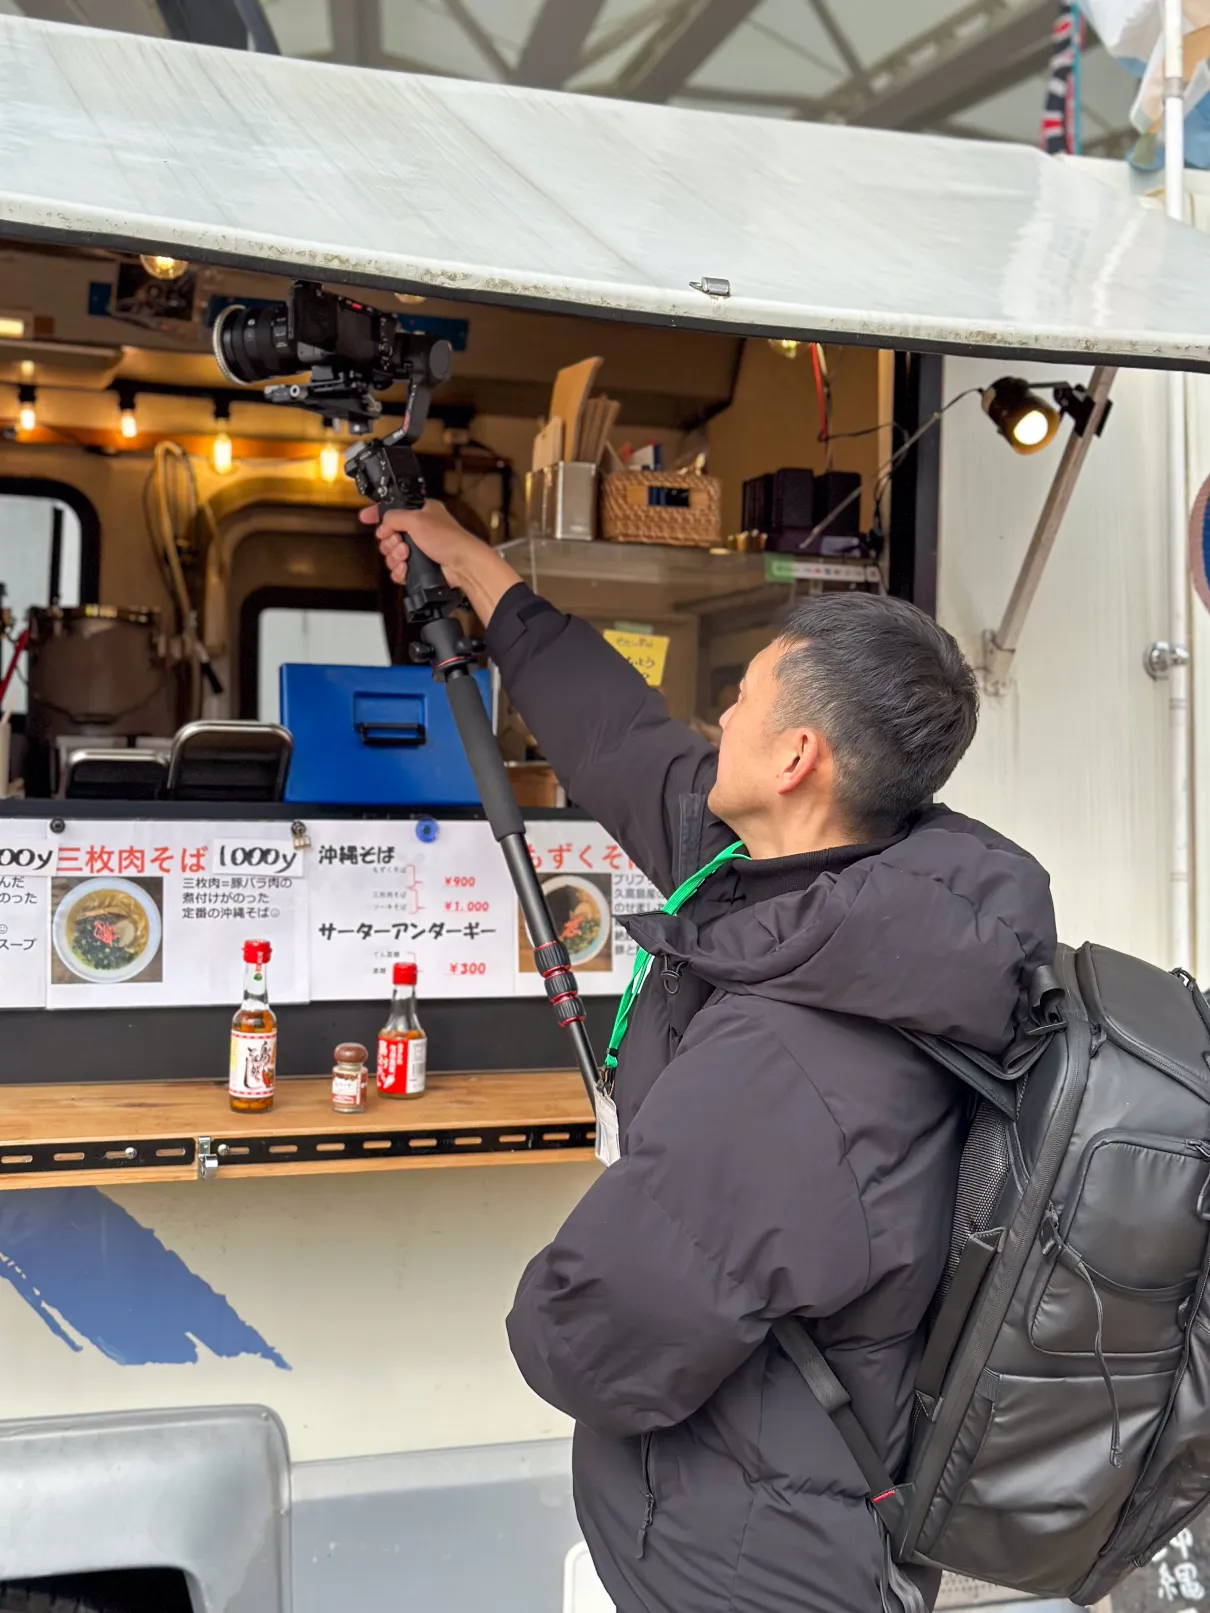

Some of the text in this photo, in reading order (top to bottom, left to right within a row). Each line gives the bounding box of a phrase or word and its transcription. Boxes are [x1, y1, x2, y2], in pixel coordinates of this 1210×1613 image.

[56, 845, 208, 873] 三枚肉そば
[318, 845, 395, 865] 沖縄そば
[528, 842, 633, 870] ずくそ
[444, 876, 476, 887] ¥900
[182, 892, 270, 904] 煮付けがのった
[318, 922, 496, 940] サーターアンダーギー
[449, 962, 486, 975] ¥300
